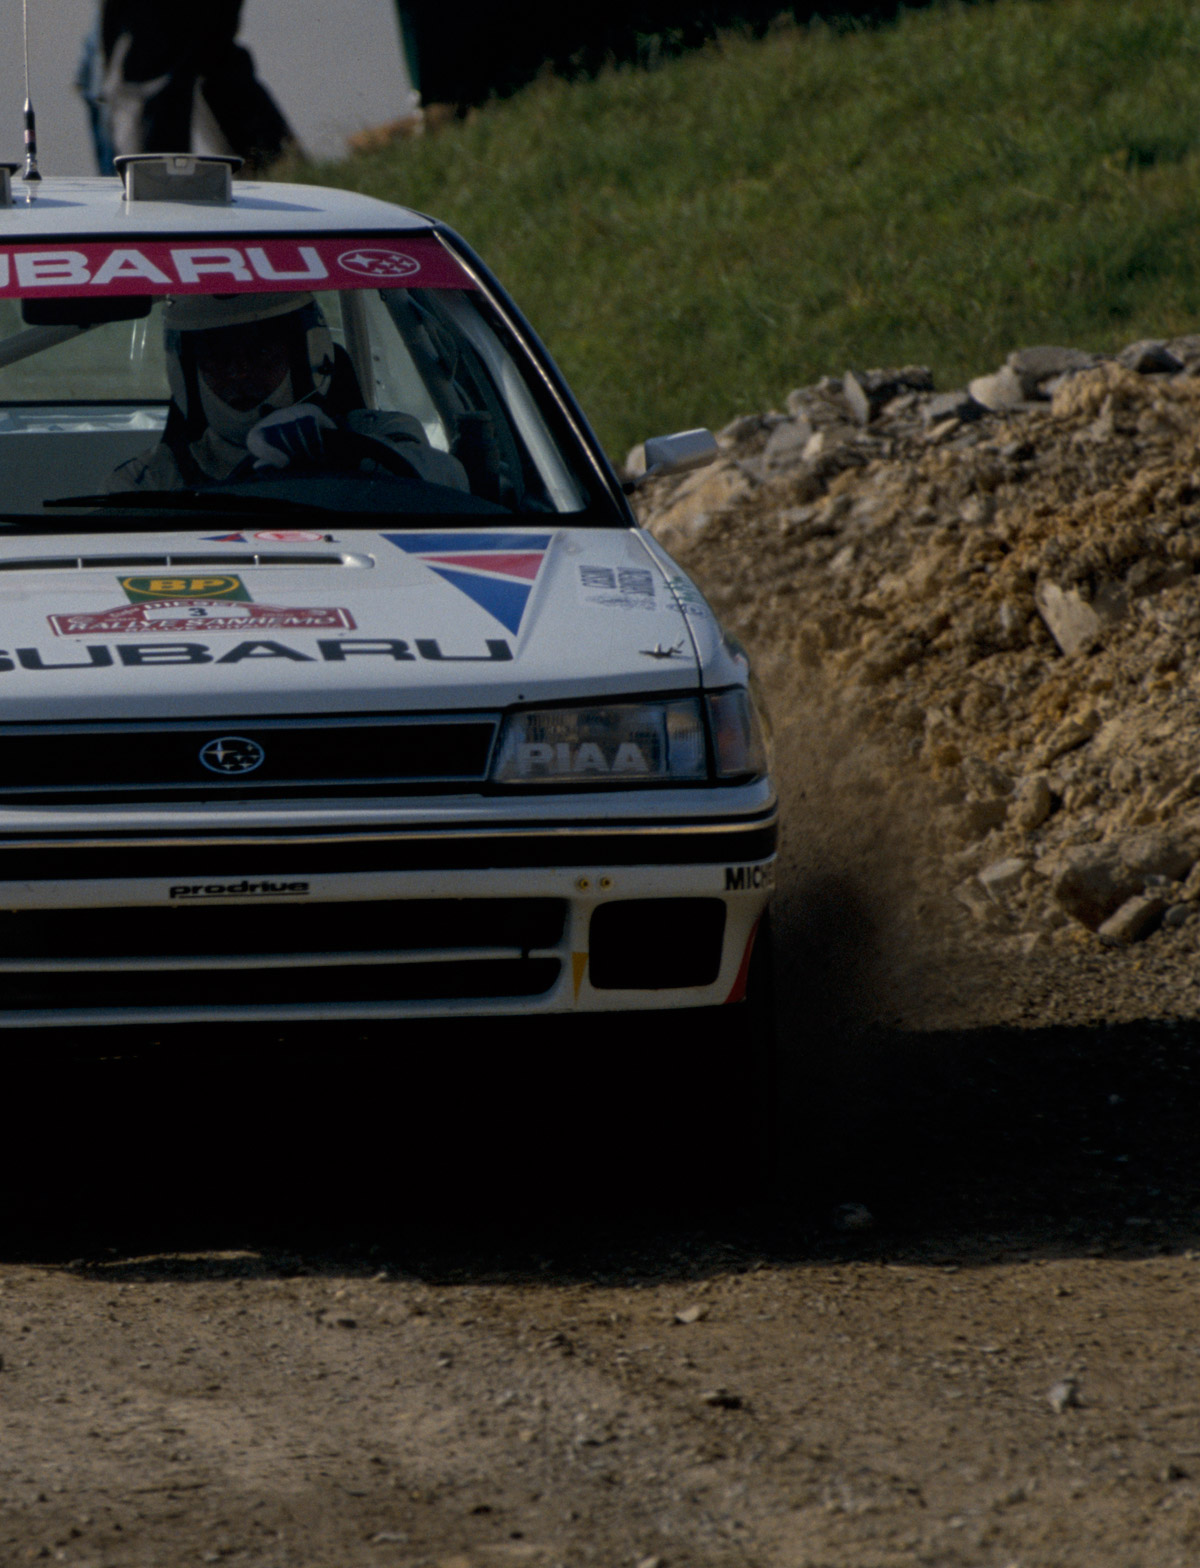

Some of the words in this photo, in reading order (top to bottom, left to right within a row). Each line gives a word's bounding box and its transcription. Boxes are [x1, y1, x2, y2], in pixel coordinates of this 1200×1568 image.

[149, 578, 226, 591] BP
[187, 607, 208, 617] 3
[516, 742, 649, 777] PIAA
[169, 881, 309, 899] prodrive
